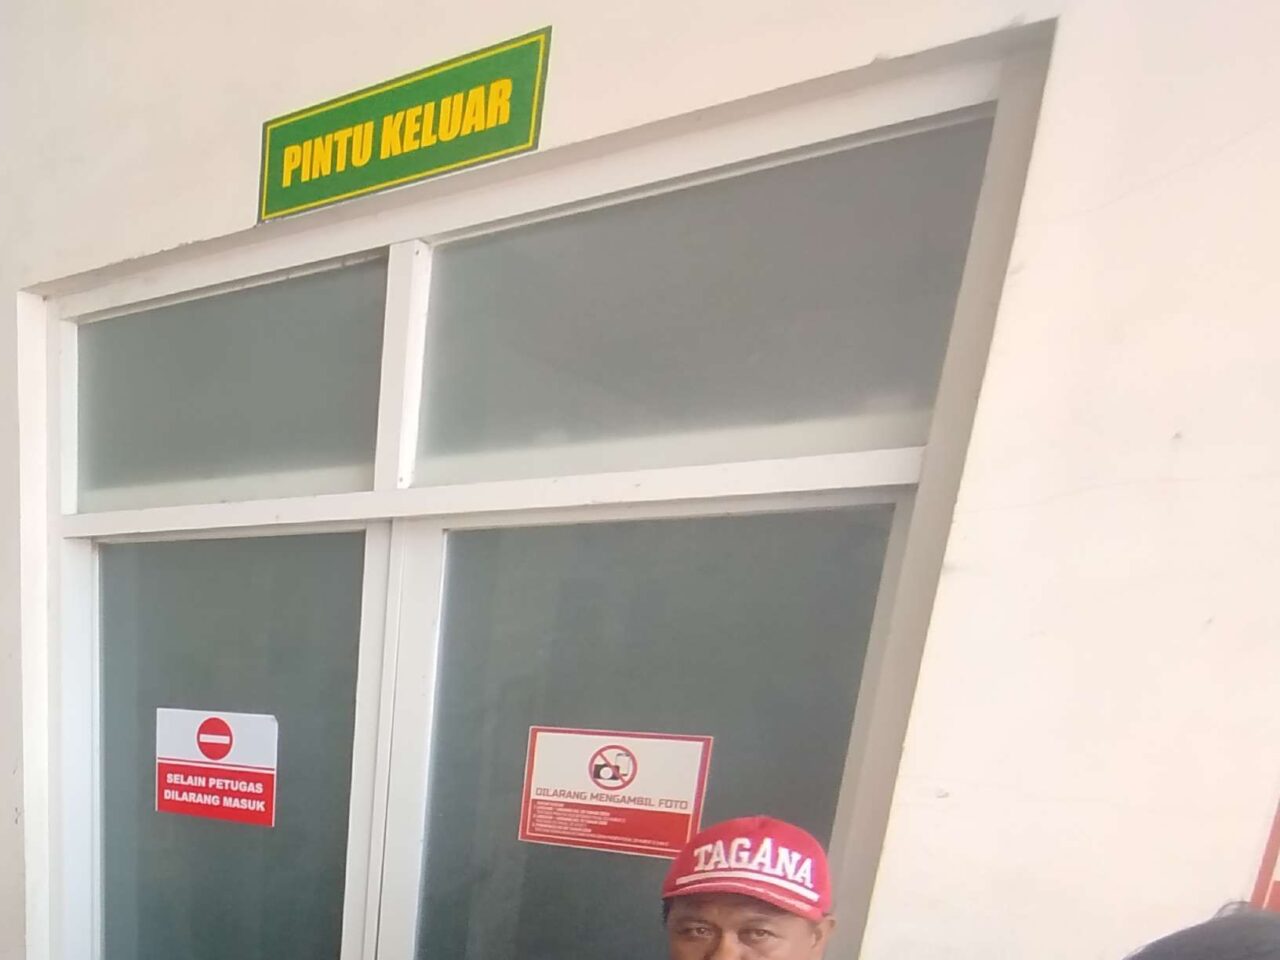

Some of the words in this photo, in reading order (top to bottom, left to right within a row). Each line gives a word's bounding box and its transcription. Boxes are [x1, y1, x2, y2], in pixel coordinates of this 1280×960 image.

[282, 121, 375, 188] PINTU
[380, 78, 513, 160] KELUAR
[166, 773, 207, 787] SELAIN
[208, 777, 264, 794] PETUGAS
[163, 789, 220, 806] DILARANG
[222, 796, 266, 812] MASUK
[535, 787, 588, 801] DILARANG
[589, 791, 655, 808] MENGAMBIL
[658, 798, 689, 811] FOTO
[694, 837, 814, 889] TAGANA
